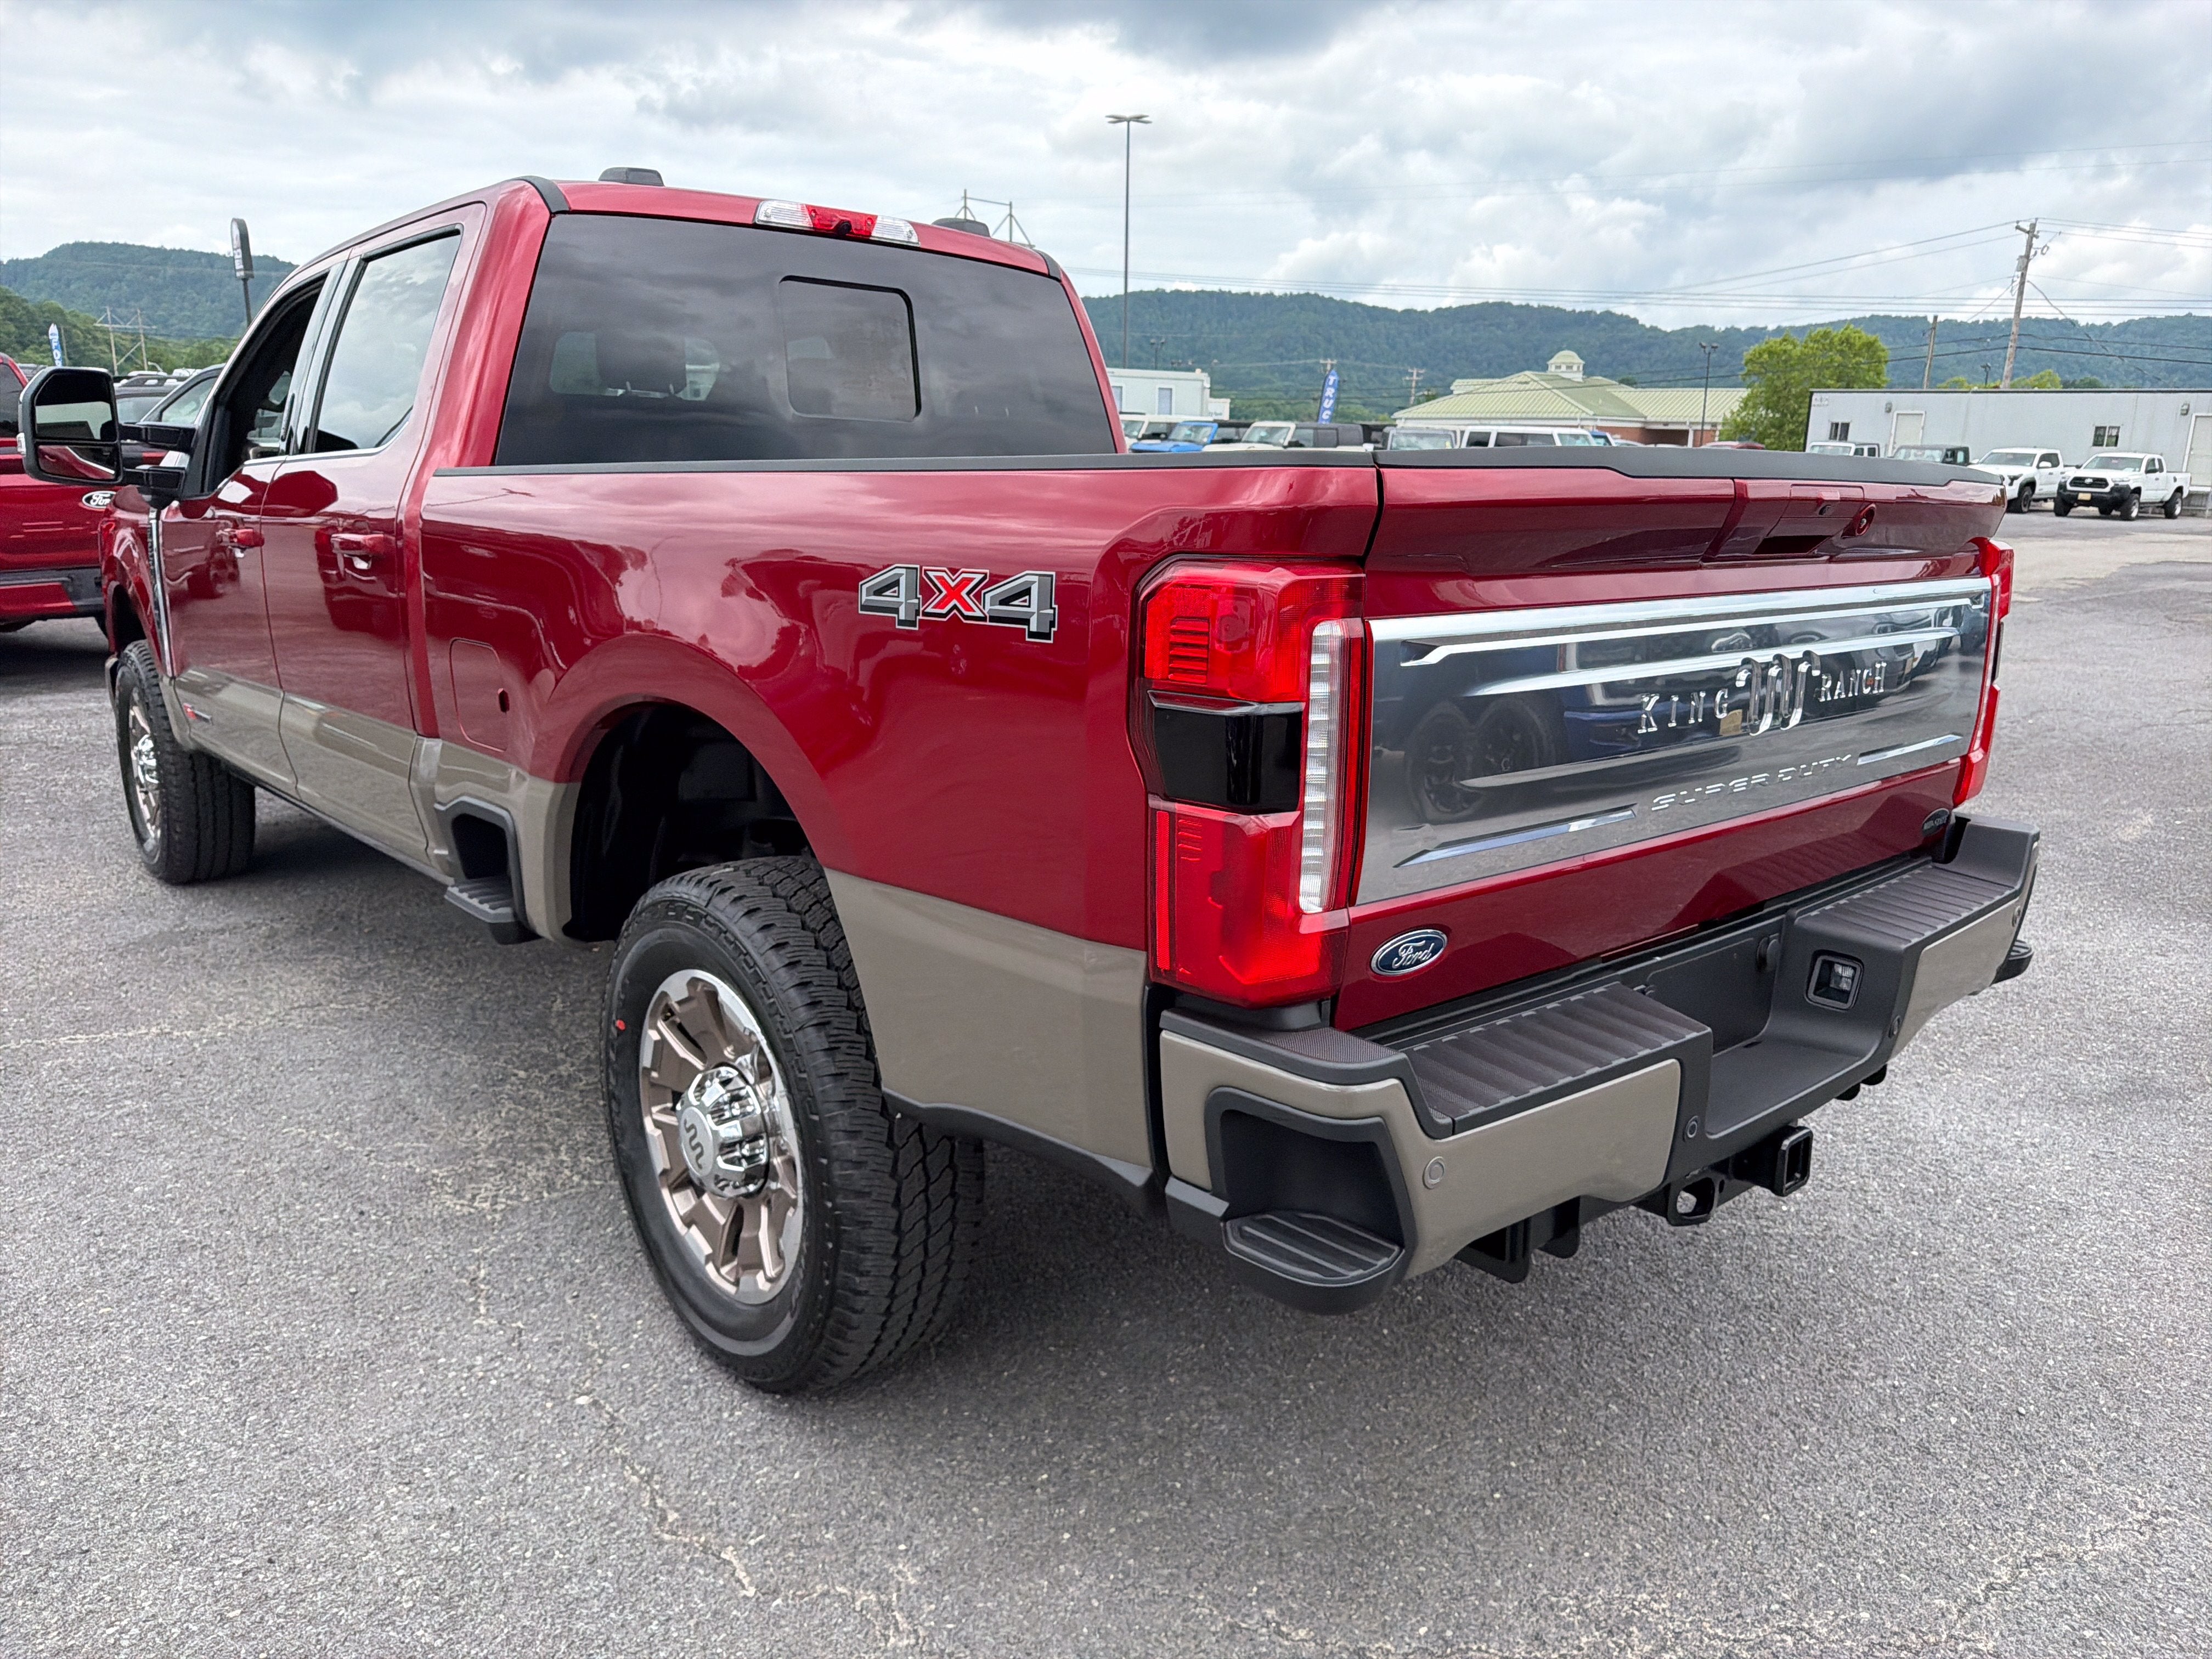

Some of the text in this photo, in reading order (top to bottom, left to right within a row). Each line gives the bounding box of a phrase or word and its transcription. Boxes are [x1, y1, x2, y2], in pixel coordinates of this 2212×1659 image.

[1322, 375, 1336, 424] TRUC
[90, 493, 111, 506] For
[1637, 661, 1887, 734] KING RANCH
[1651, 754, 1852, 811] SUPER DUTY
[1391, 940, 1435, 969] Ford
